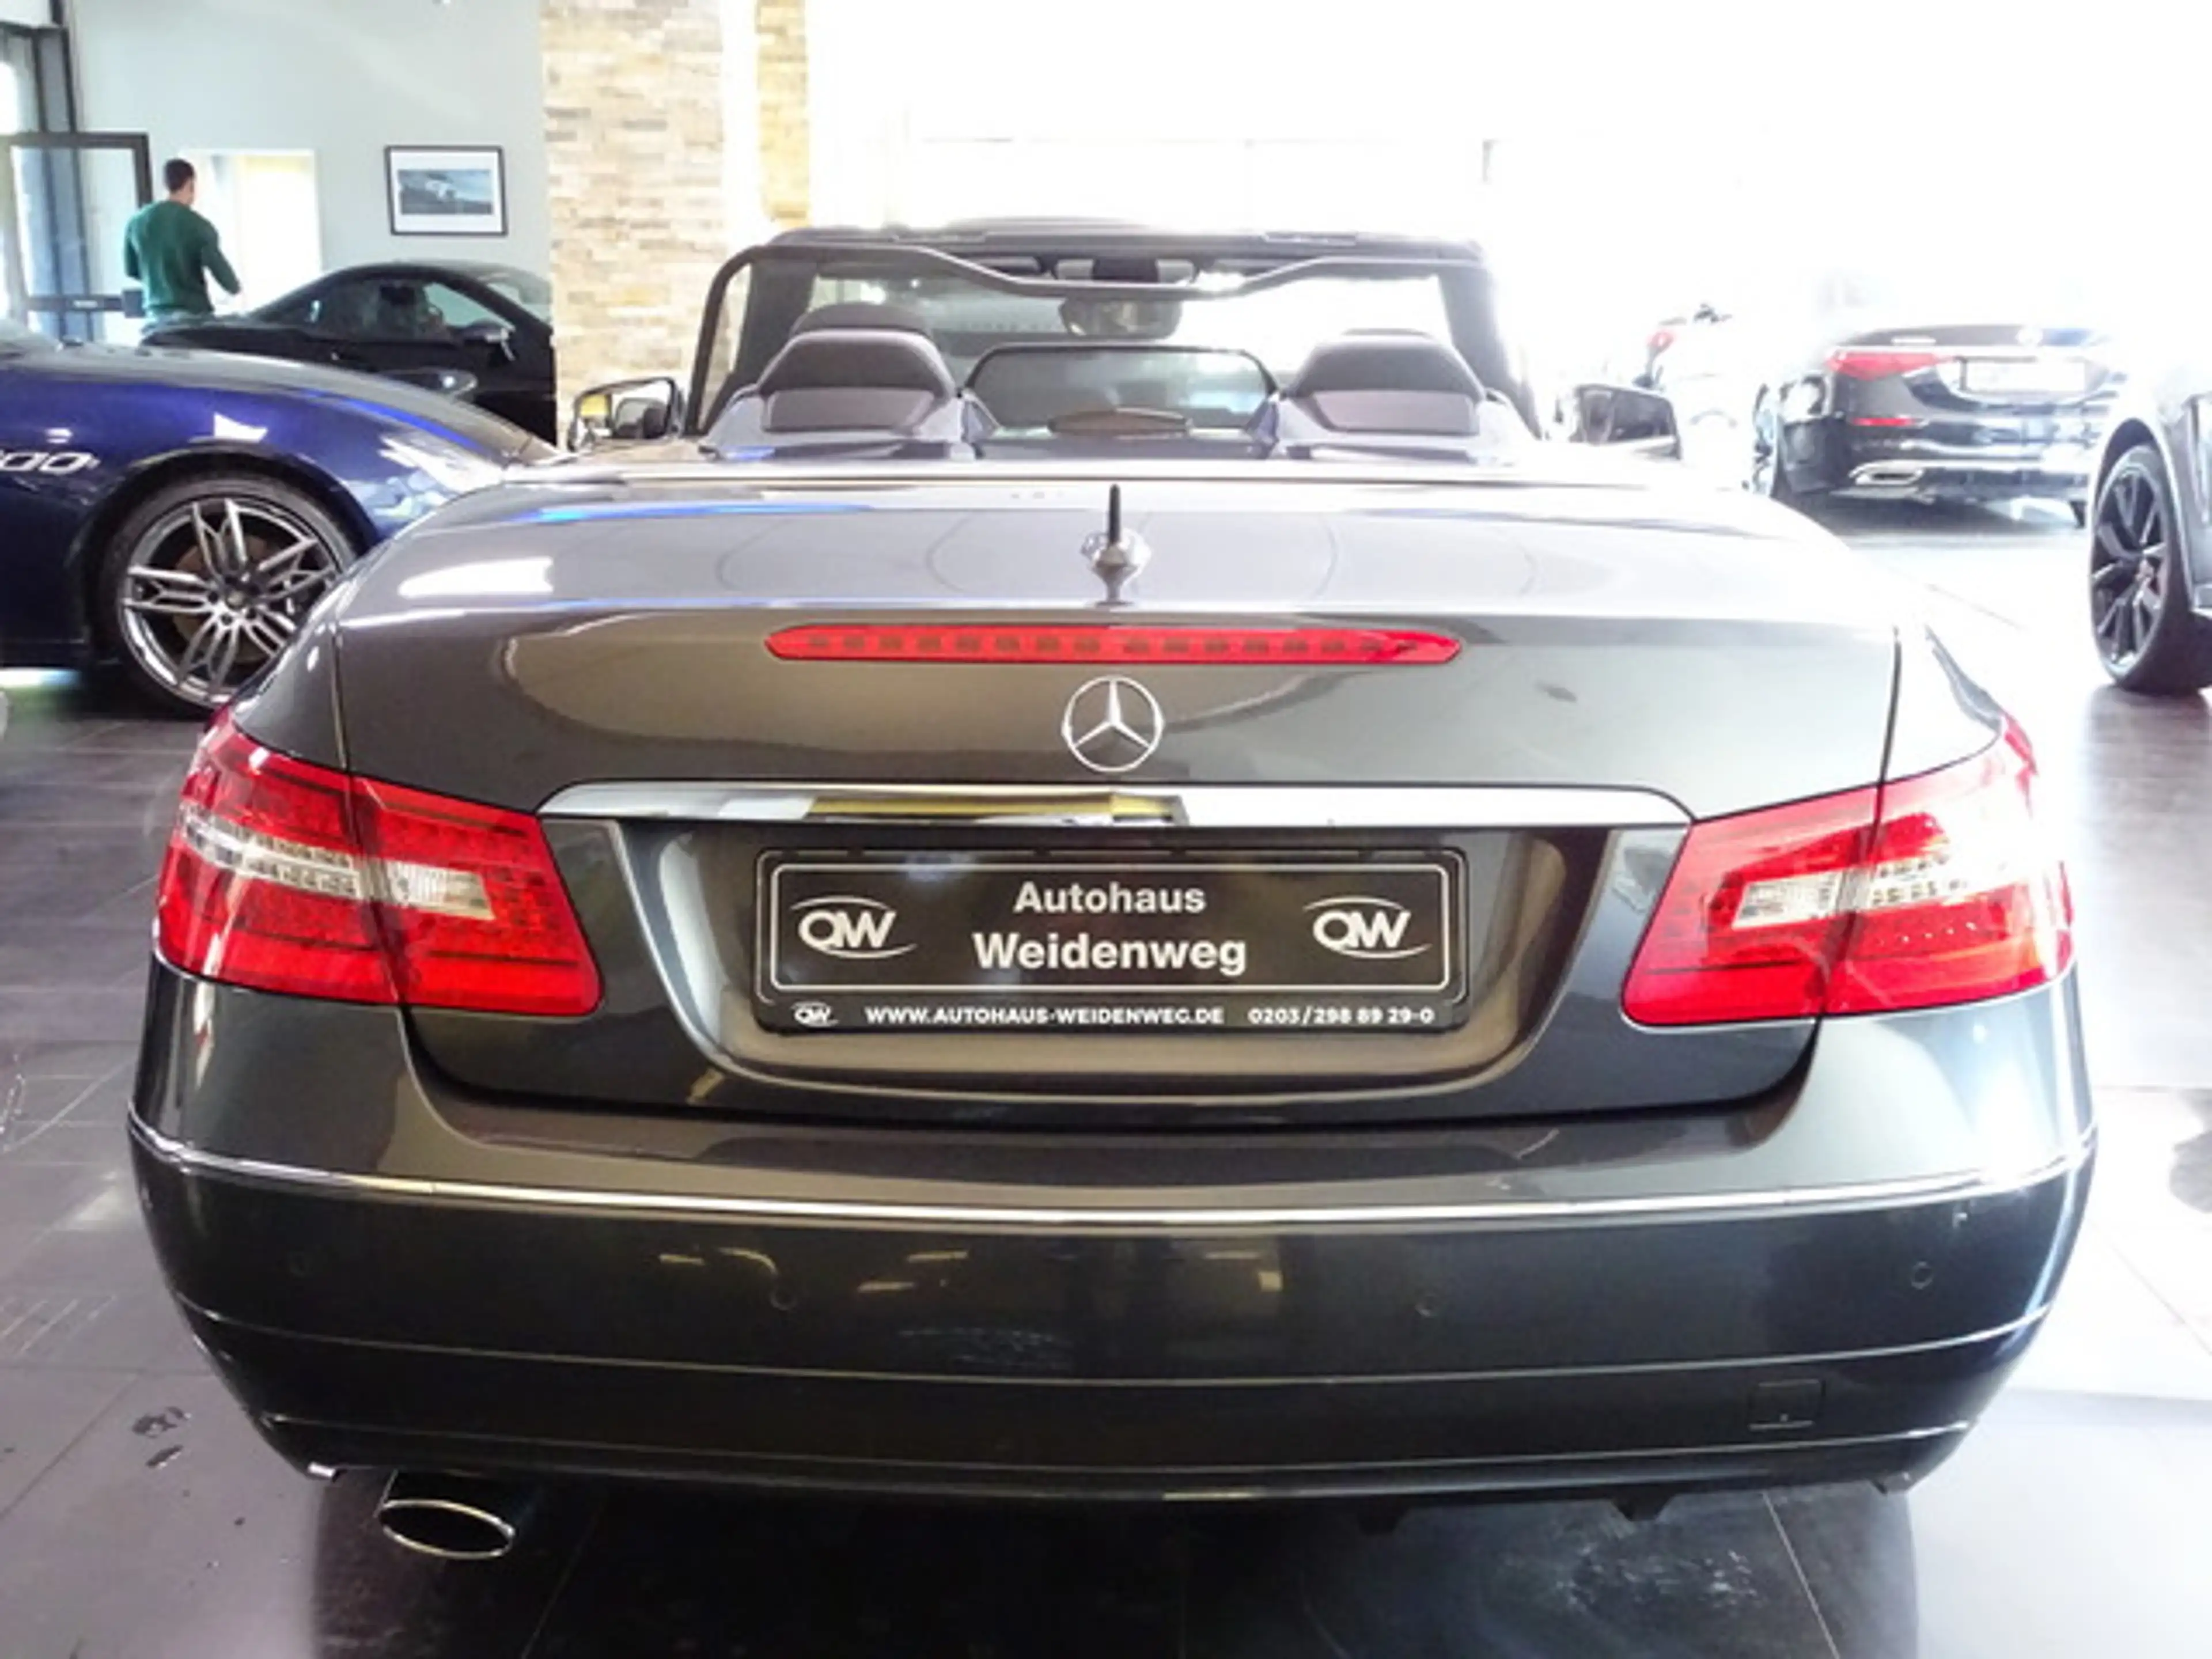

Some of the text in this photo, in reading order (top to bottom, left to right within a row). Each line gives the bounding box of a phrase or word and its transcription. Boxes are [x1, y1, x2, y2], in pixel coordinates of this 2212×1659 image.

[1014, 882, 1206, 913] Autohaus
[972, 933, 1246, 976] Weidenweg
[865, 1007, 1224, 1024] WWW.AUTOHAUS-WEIDENWEG.DE
